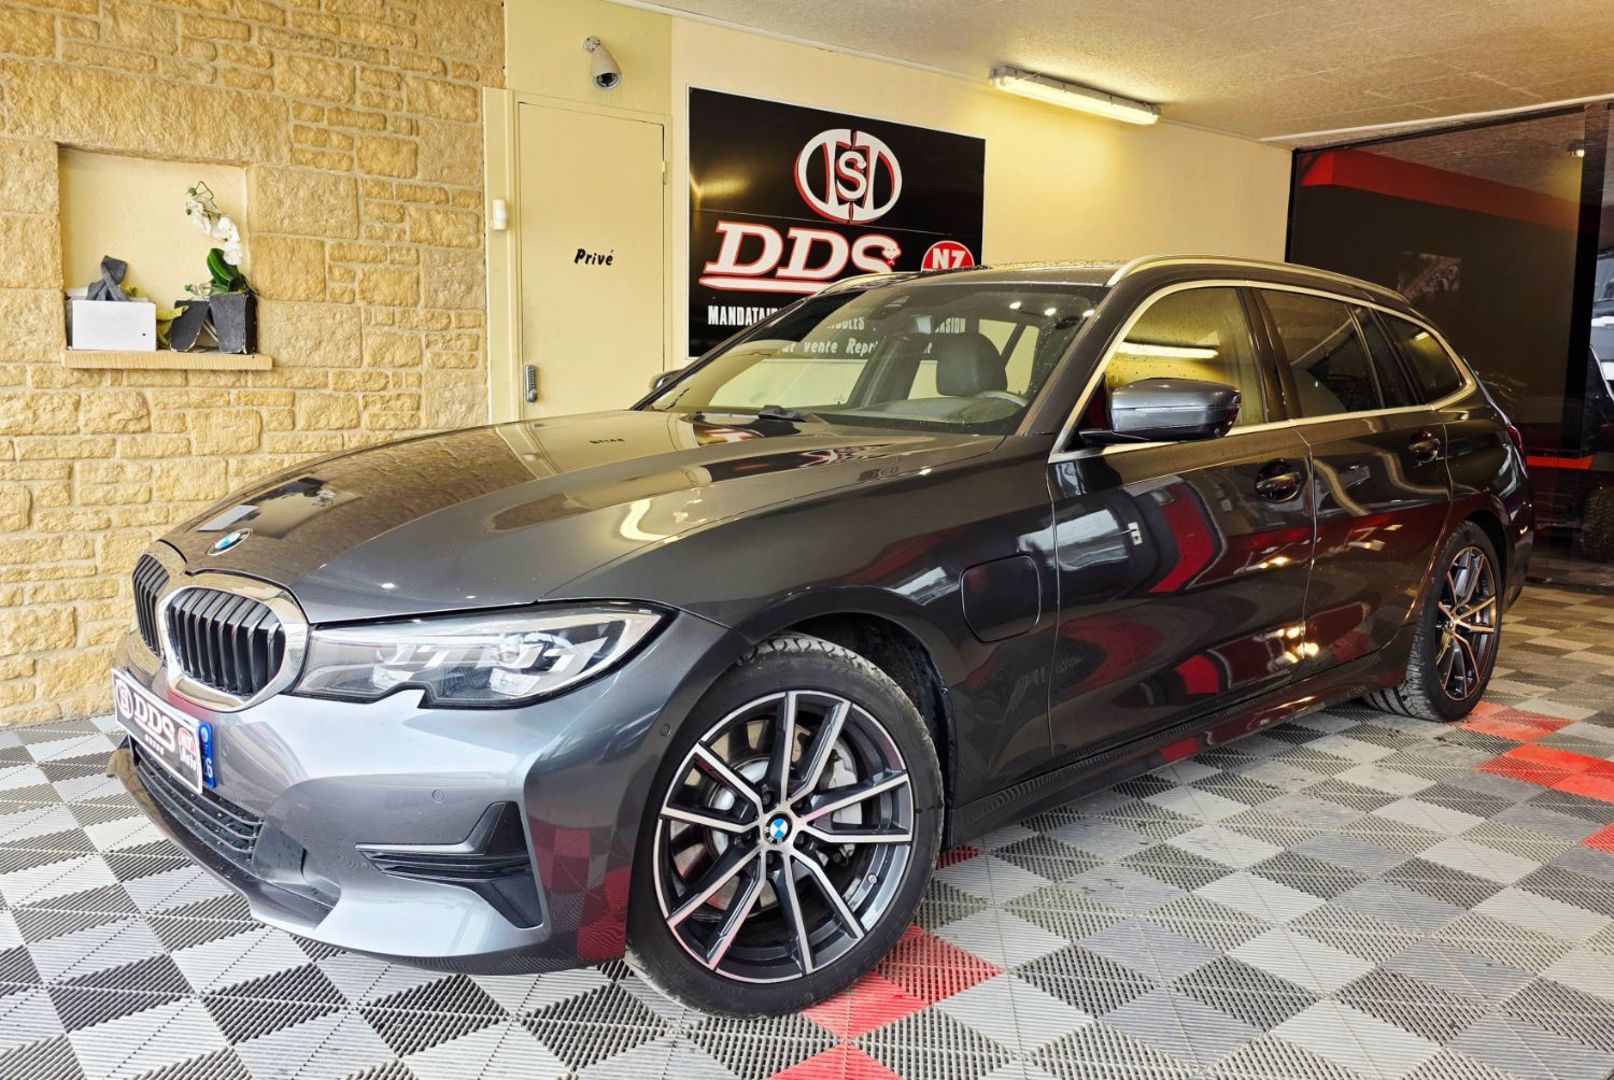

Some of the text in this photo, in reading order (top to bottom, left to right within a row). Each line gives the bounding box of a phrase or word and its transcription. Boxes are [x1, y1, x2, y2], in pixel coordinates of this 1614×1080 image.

[574, 248, 614, 266] Privé
[703, 220, 901, 281] DDS
[803, 341, 838, 354] vente
[133, 692, 176, 748] DDS
